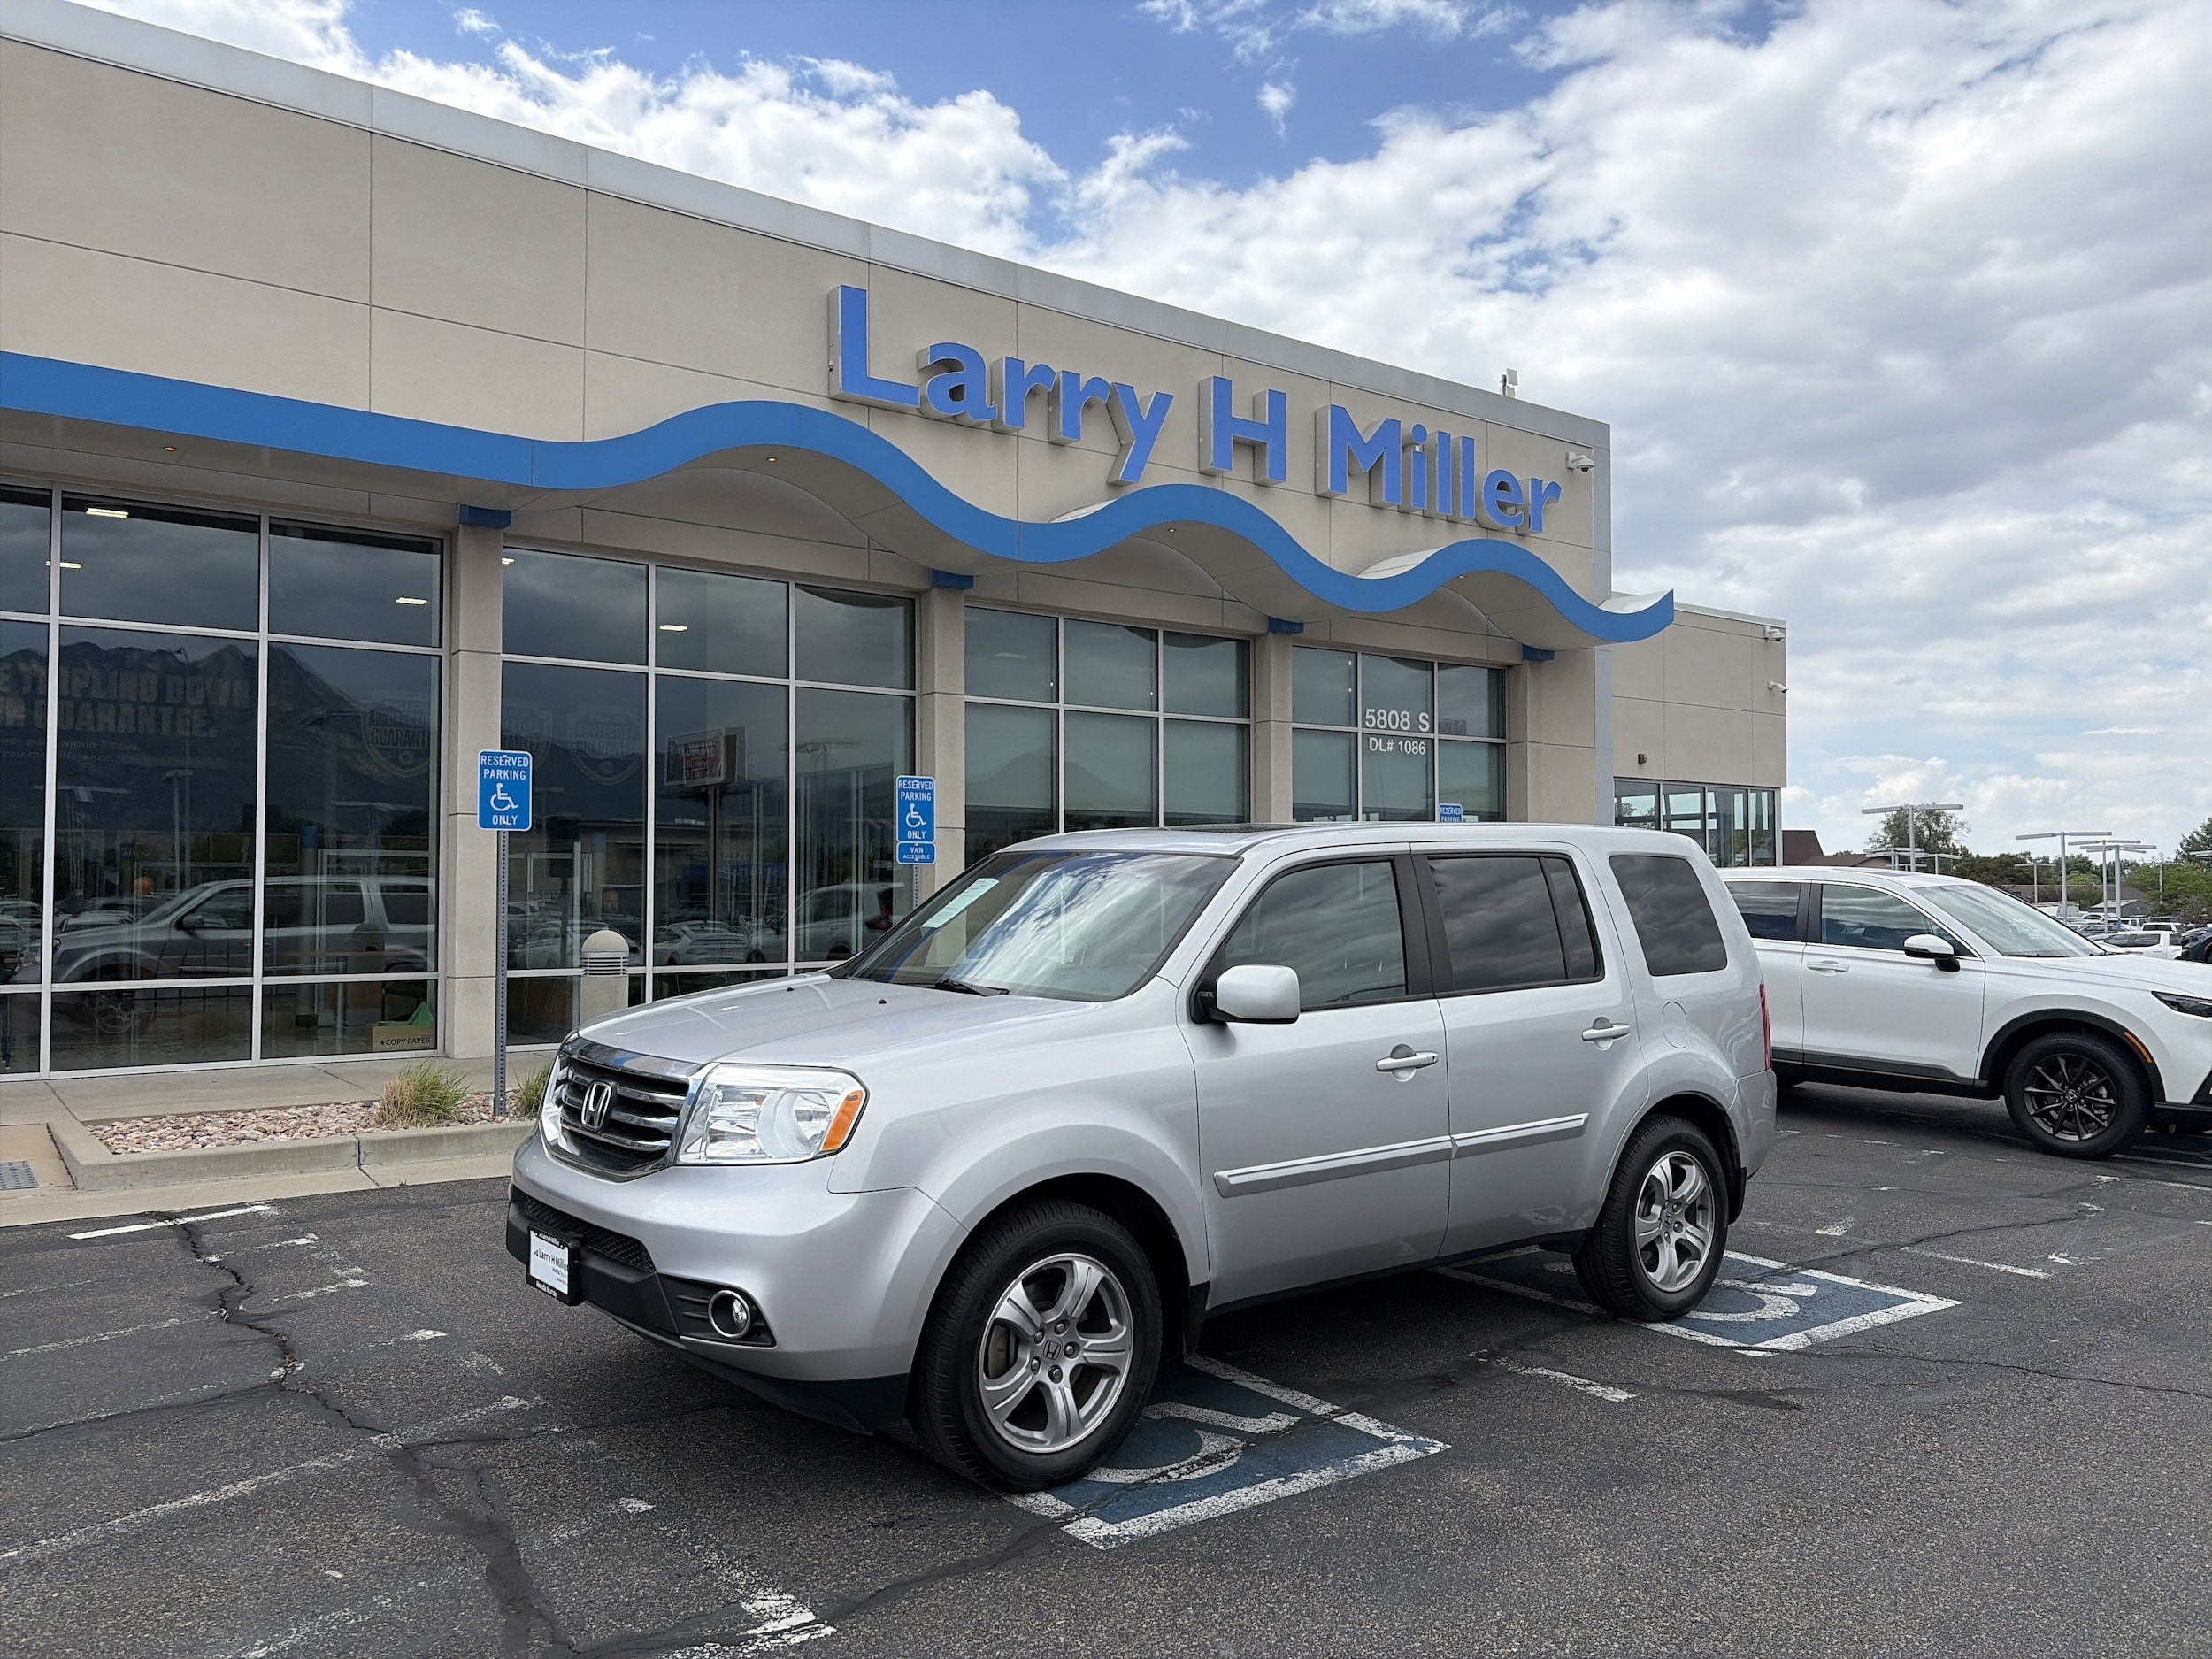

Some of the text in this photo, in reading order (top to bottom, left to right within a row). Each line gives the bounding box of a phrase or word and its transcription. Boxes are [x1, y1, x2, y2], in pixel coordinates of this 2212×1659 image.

[831, 285, 1562, 534] Larry H Miller
[1365, 708, 1430, 733] 5808 S
[1369, 736, 1426, 755] DL# 1086
[480, 755, 529, 767] RESERVED
[483, 769, 526, 780] PARKING
[898, 780, 933, 790] RESERVED
[901, 792, 932, 801] PARKING
[1440, 806, 1461, 815] RESERVED
[492, 815, 518, 826] ONLY
